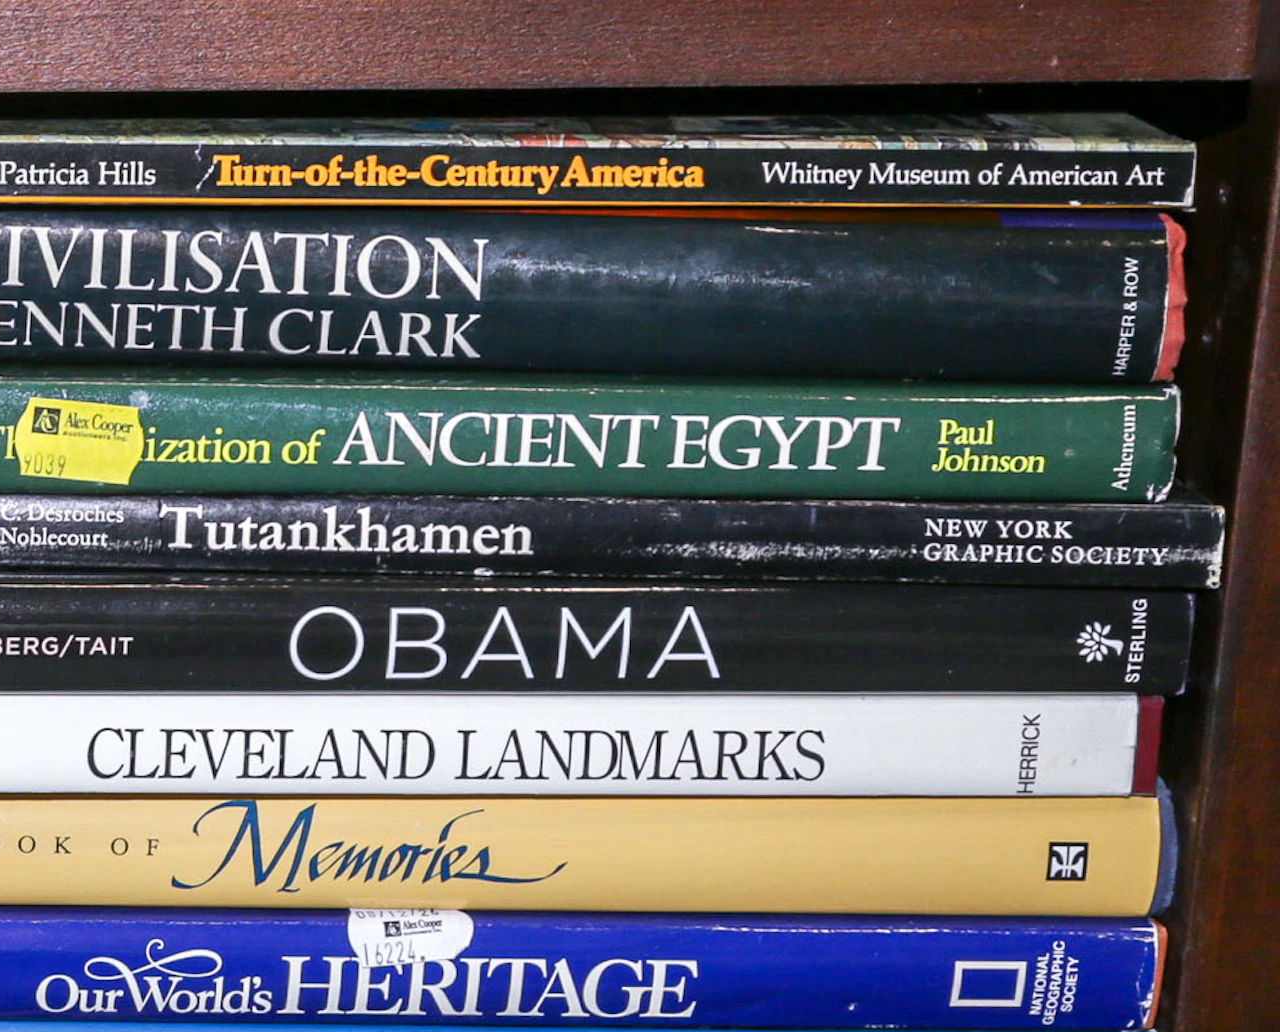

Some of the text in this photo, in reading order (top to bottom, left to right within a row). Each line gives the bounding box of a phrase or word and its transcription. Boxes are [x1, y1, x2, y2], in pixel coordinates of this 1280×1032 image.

[98, 161, 156, 185] Hills
[213, 155, 704, 194] Turn-of-the-Century America
[762, 161, 1165, 189] Whitney Museum of American Art
[269, 310, 481, 359] CLARK
[1112, 257, 1139, 376] HARPER & ROW
[64, 412, 133, 433] Alex Cooper
[937, 419, 994, 446] Paul
[23, 452, 66, 476] 9039
[931, 447, 1046, 474] Johnson
[0, 527, 108, 546] Noblecourt
[159, 506, 533, 555] Tutankhamen
[924, 519, 1073, 540] NEW YORK
[288, 605, 722, 680] OBAMA
[1125, 598, 1148, 683] STERLING
[86, 726, 826, 782] CLEVELAND LANDMARKS
[1017, 714, 1041, 793] HERRICK
[36, 938, 698, 1018] Our World's HERITAGE
[1029, 952, 1050, 1015] NATIONAL
[1042, 941, 1066, 1025] GEOGRAPHIC
[1061, 956, 1079, 1012] SOCIETY
